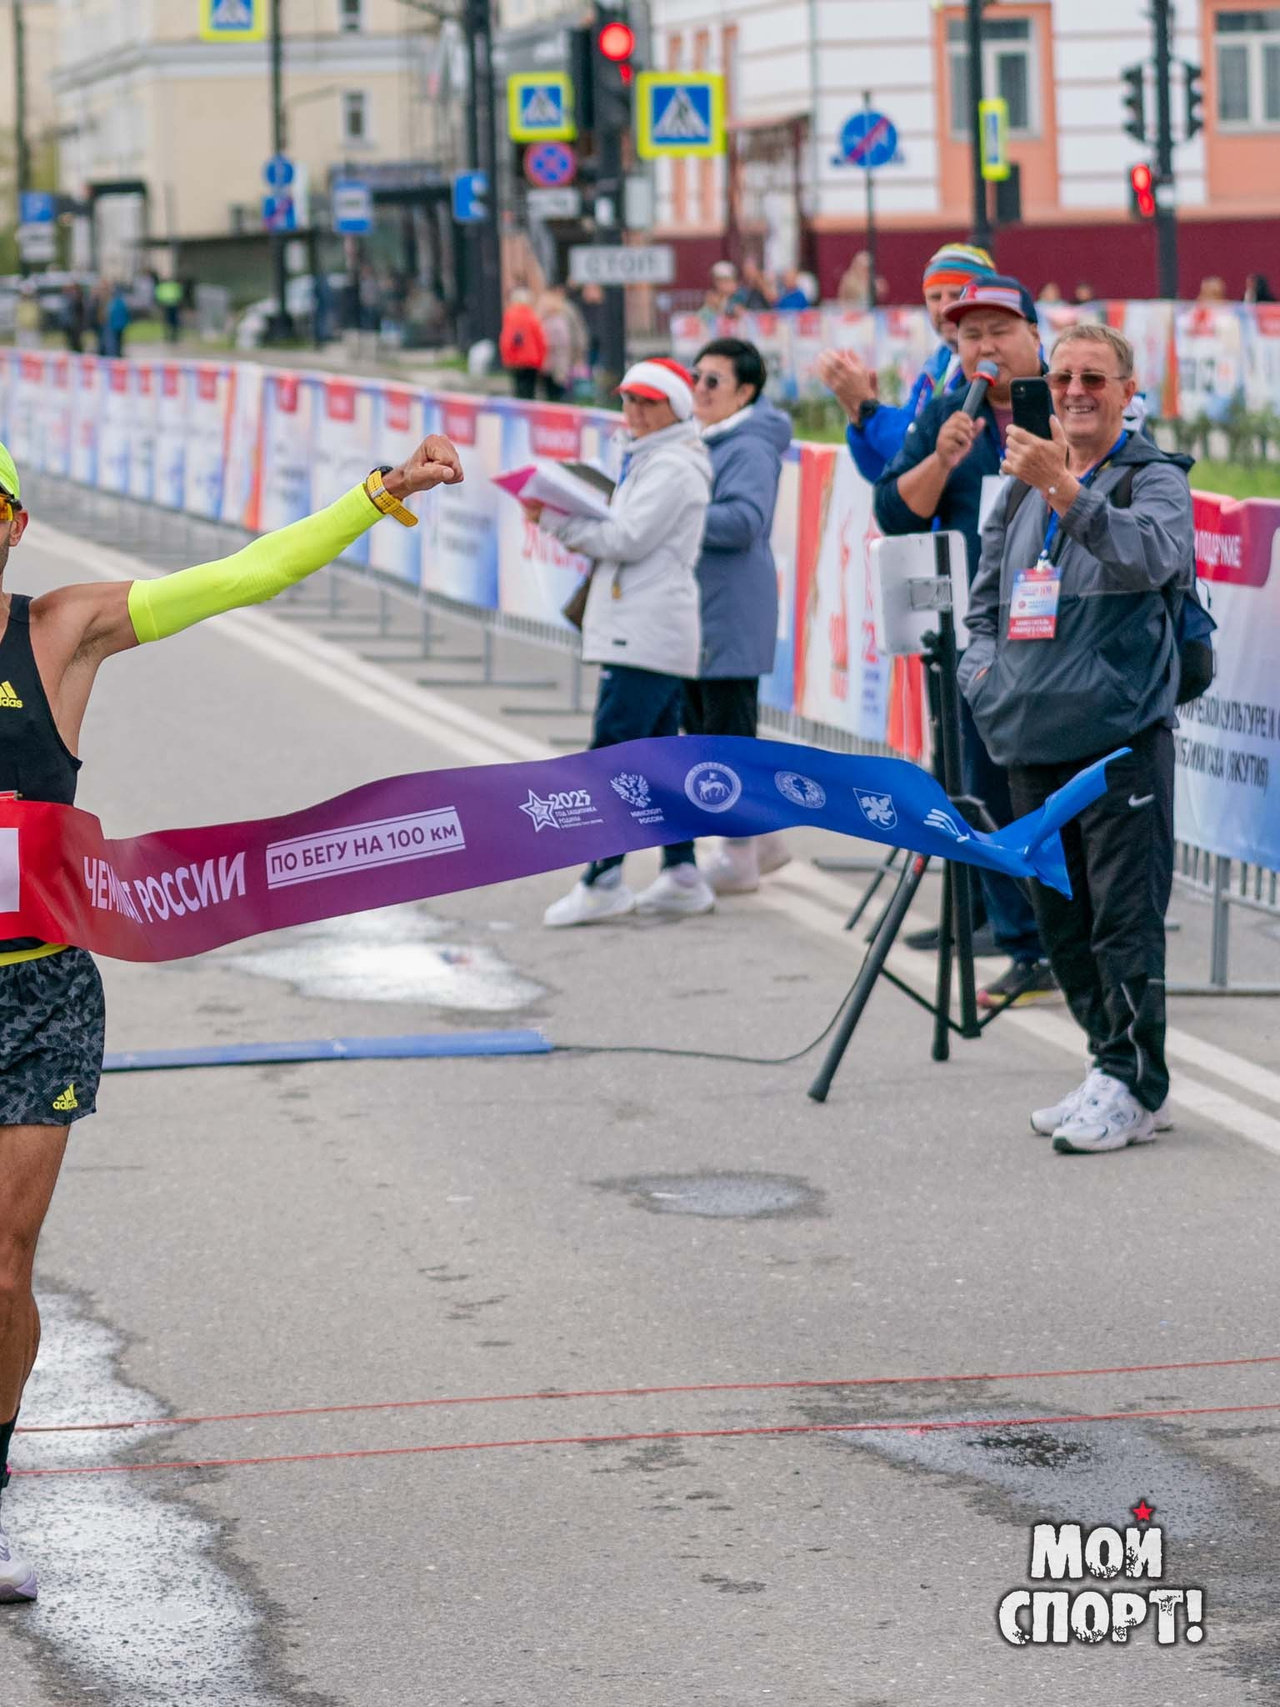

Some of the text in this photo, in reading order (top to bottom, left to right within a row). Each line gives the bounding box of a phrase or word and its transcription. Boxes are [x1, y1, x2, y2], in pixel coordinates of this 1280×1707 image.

[548, 789, 591, 810] 2025
[271, 853, 298, 874] ПО
[302, 841, 348, 867] БЕГУ
[353, 835, 384, 857] НА
[386, 826, 425, 849] 100
[132, 851, 247, 923] РОССИИ
